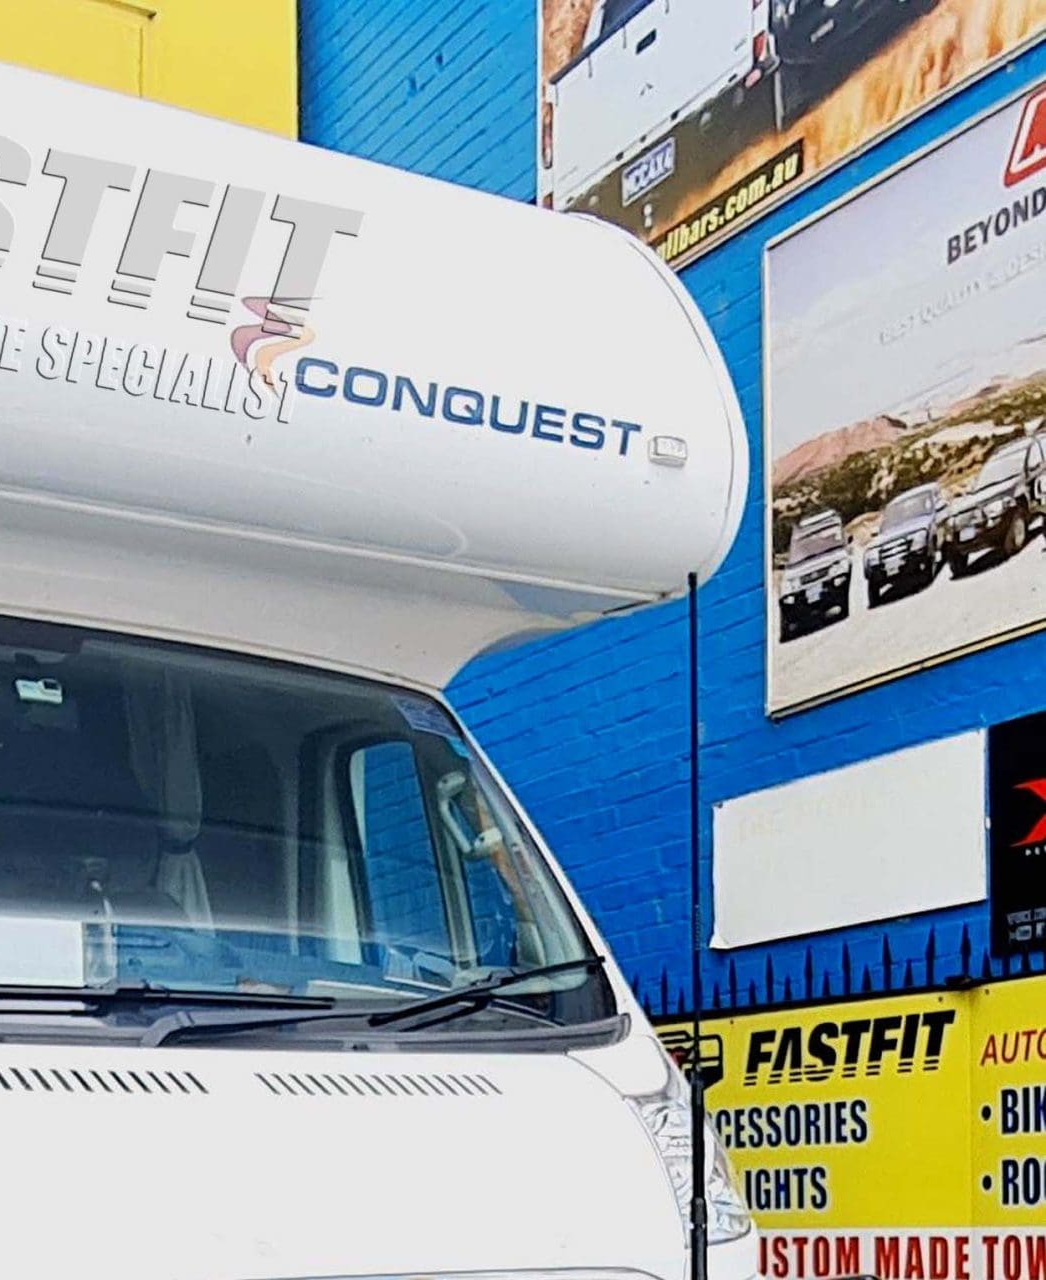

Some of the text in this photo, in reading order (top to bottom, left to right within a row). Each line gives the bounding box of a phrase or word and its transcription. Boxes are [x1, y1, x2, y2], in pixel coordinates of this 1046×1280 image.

[295, 356, 642, 457] CONQUEST
[743, 1009, 956, 1087] FASTFIT
[707, 1099, 868, 1149] CESSORIES
[745, 1166, 828, 1210] IGHTS
[1001, 1157, 1046, 1206] RO
[874, 1235, 971, 1280] MADE
